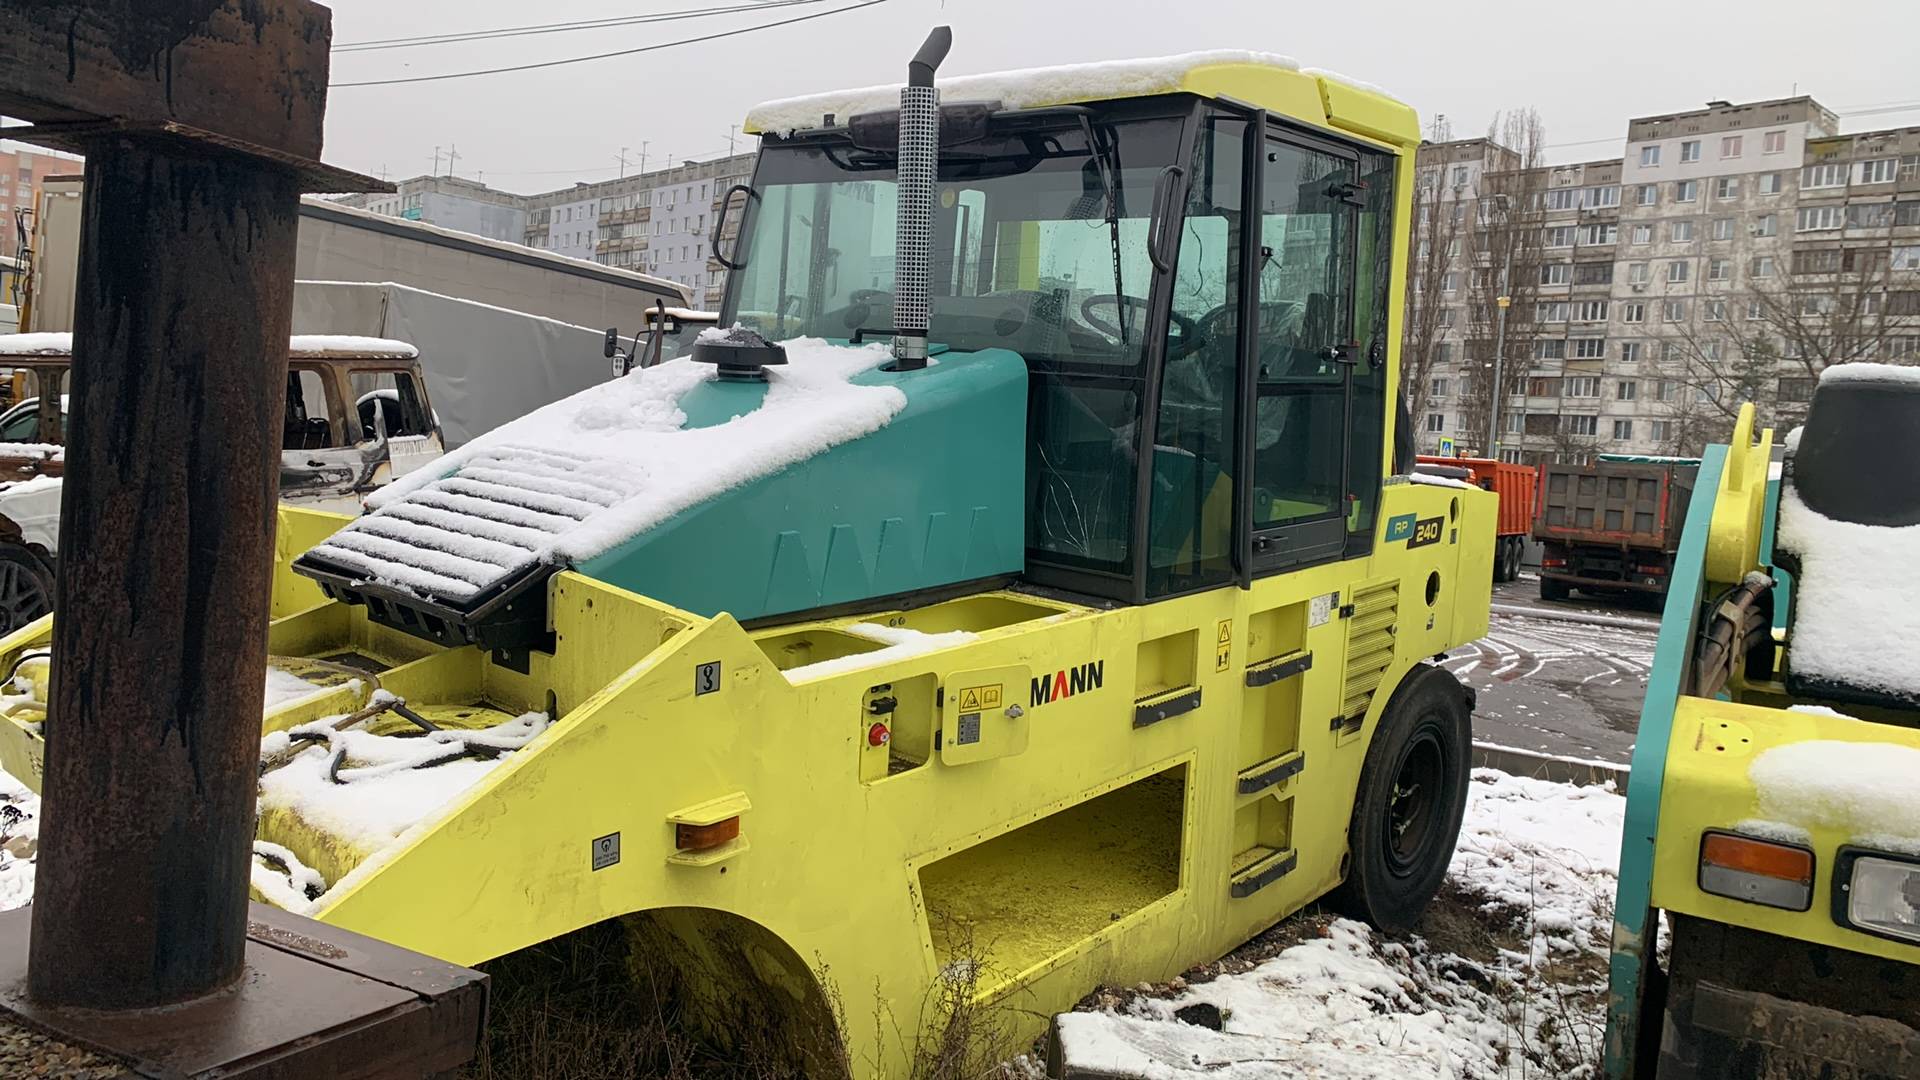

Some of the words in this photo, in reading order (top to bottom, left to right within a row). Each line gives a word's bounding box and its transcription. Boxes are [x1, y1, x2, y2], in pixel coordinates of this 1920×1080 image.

[1394, 520, 1408, 535] RP
[1415, 522, 1438, 543] 240
[1030, 660, 1104, 708] MANN
